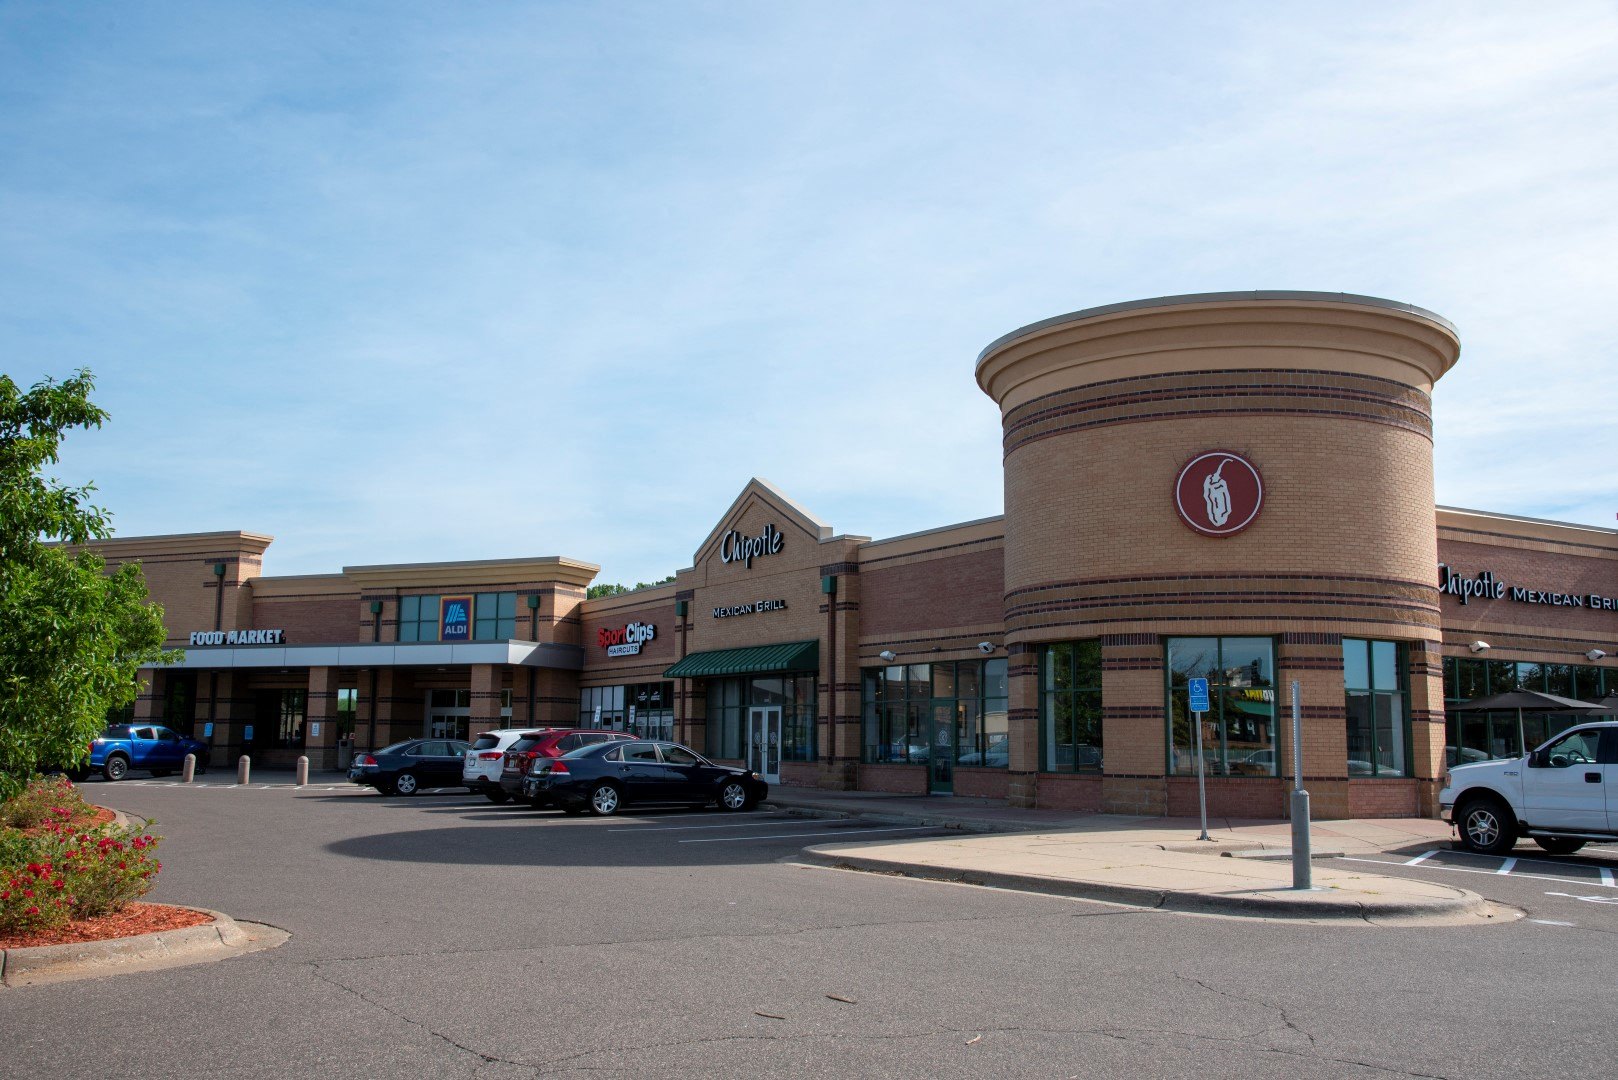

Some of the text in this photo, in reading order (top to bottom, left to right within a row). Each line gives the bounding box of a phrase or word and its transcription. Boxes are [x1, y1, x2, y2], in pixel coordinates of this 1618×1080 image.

[720, 523, 783, 569] Chipotle
[1513, 586, 1583, 607] MEXICAN
[1590, 594, 1618, 612] GRI
[712, 600, 786, 618] MEXICAN GRILL
[189, 629, 283, 646] FOOD MARKET
[444, 625, 467, 635] ALDI
[608, 645, 639, 656] HAIRCUTS
